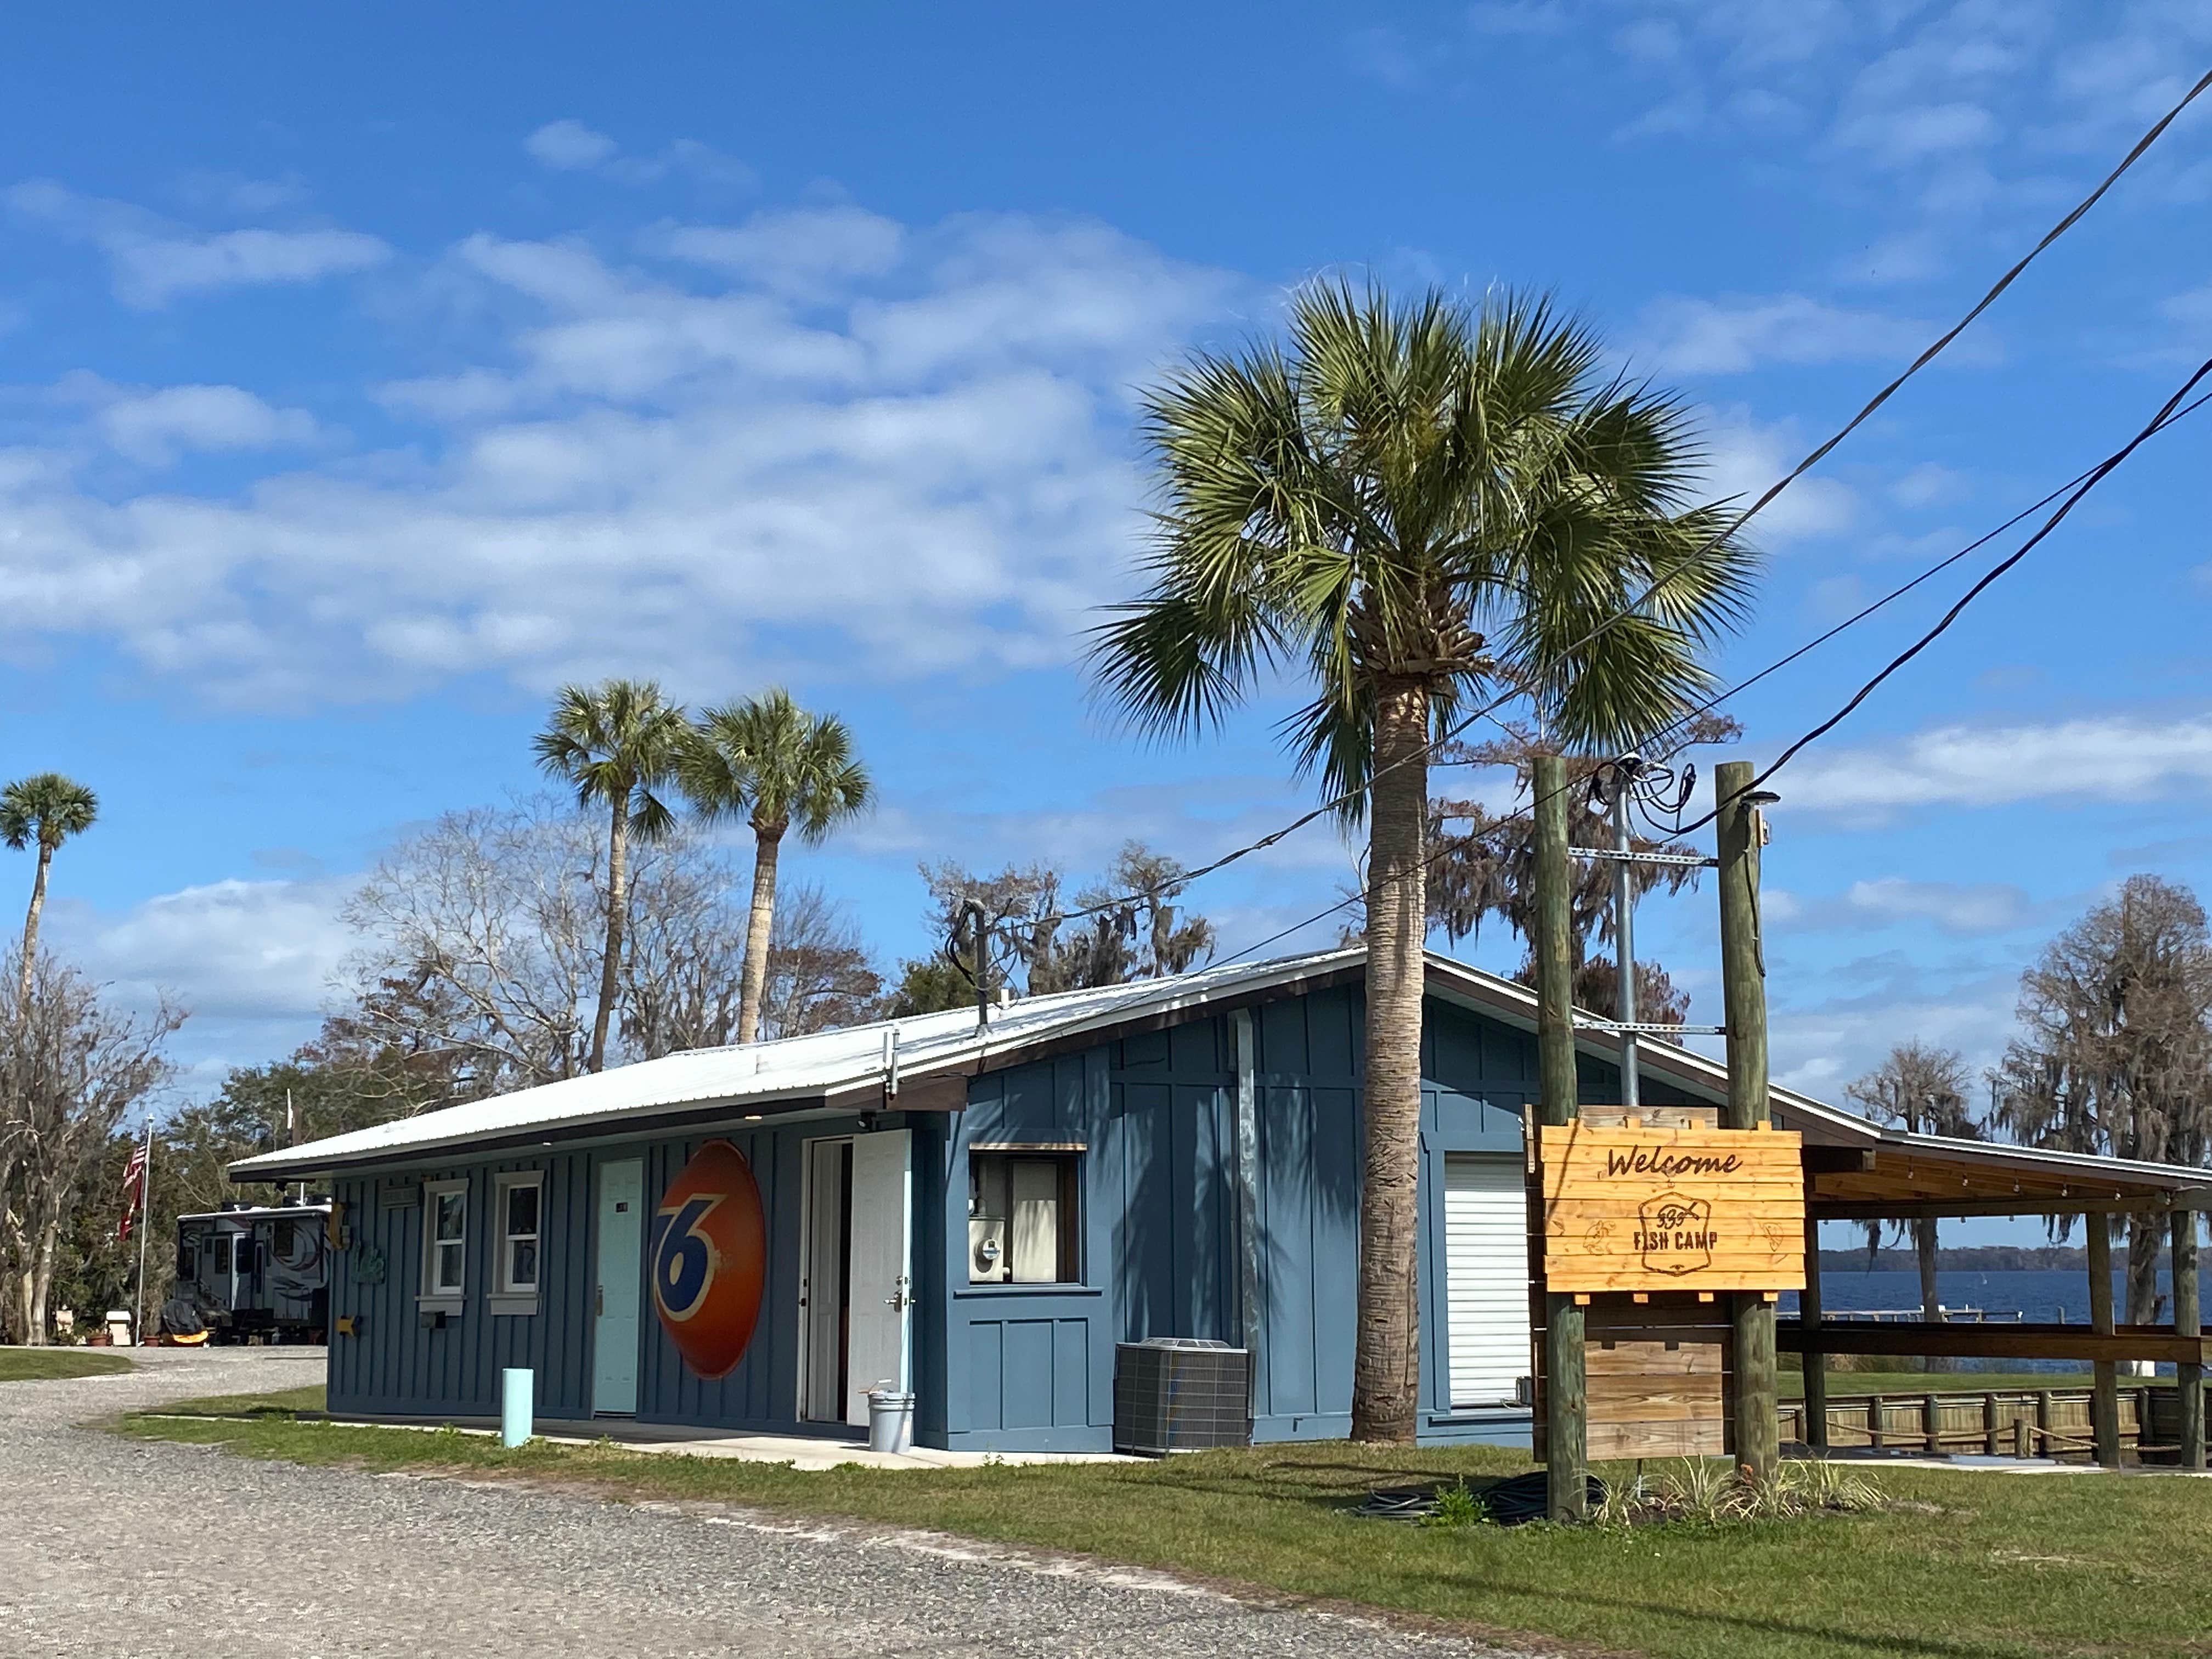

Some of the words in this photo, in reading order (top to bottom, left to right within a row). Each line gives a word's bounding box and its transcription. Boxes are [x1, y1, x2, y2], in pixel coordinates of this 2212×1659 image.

[1608, 1144, 1743, 1177] Welcome
[1633, 1232, 1669, 1250] FISH
[1675, 1232, 1718, 1250] CAMP
